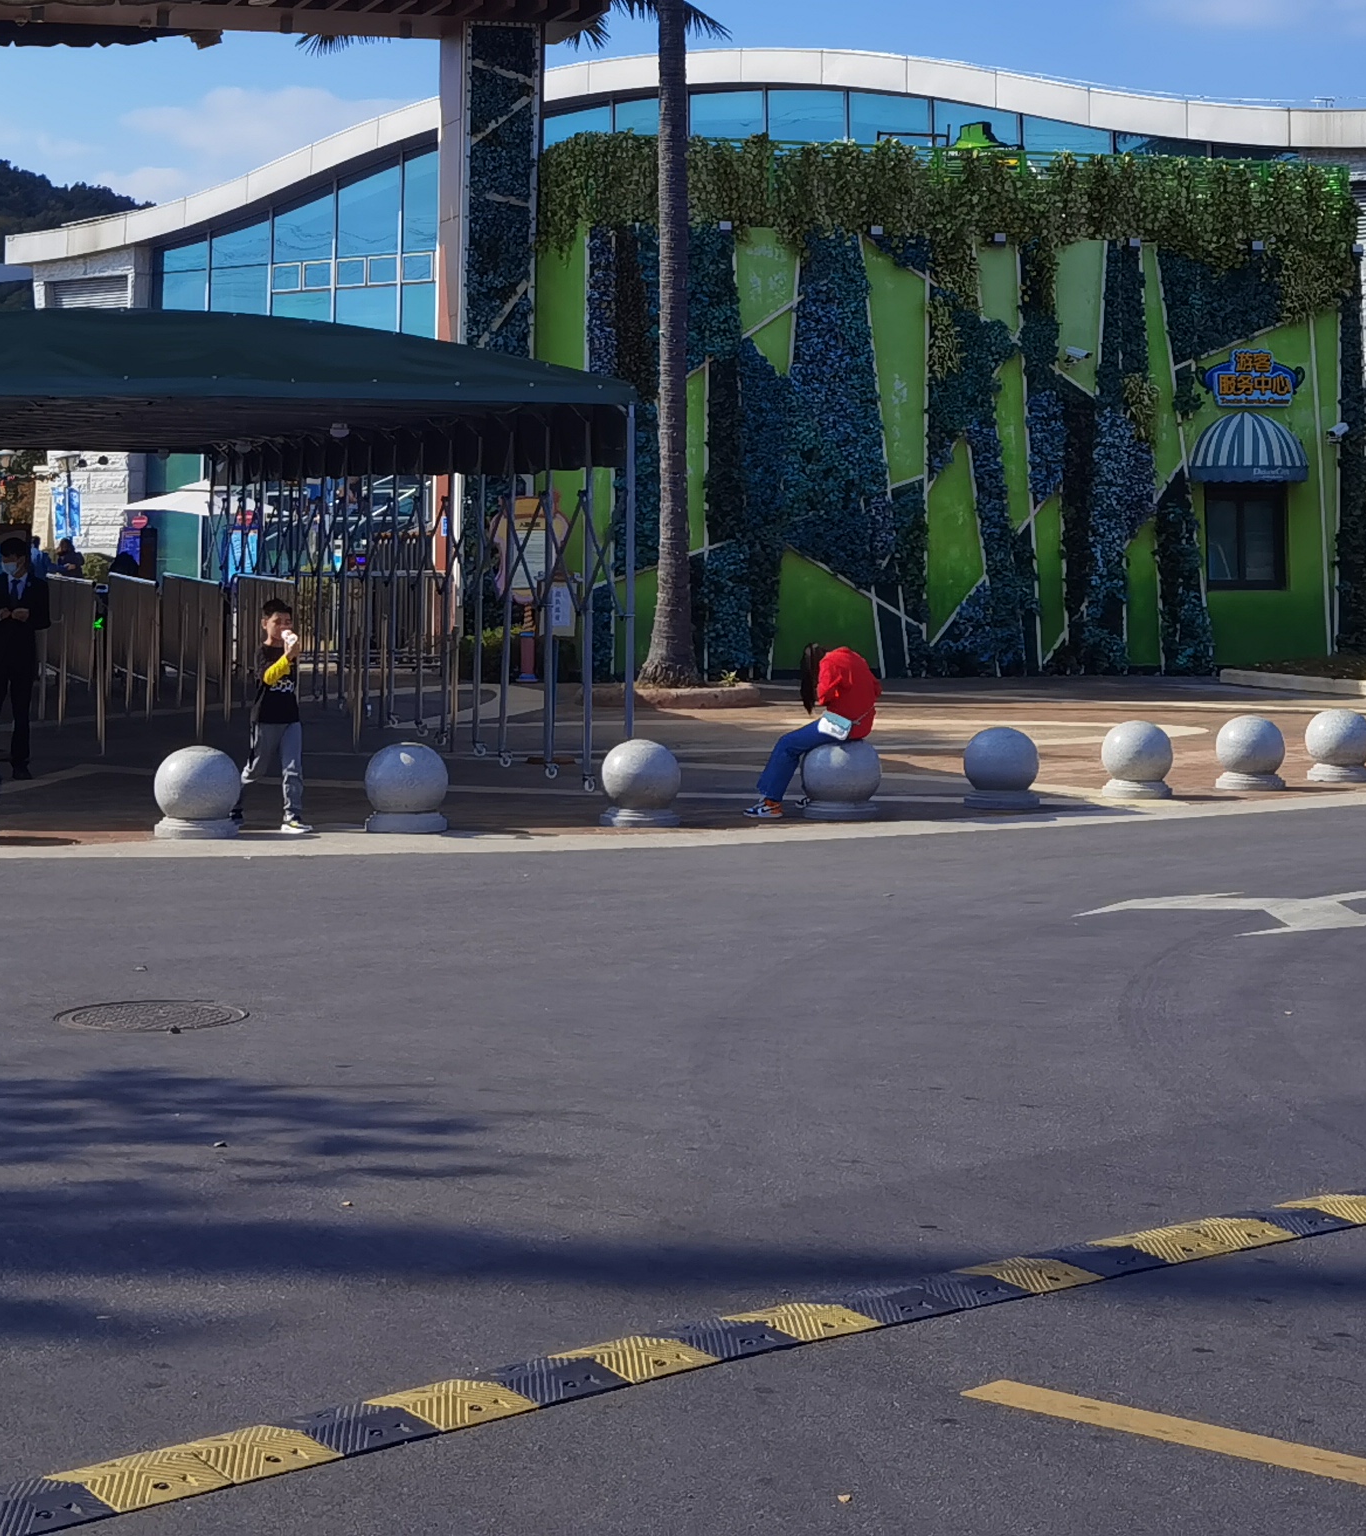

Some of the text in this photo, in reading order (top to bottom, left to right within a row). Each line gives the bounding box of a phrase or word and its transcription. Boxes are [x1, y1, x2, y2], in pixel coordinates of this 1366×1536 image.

[1235, 352, 1272, 372] 游客
[1218, 374, 1291, 395] 服务中心
